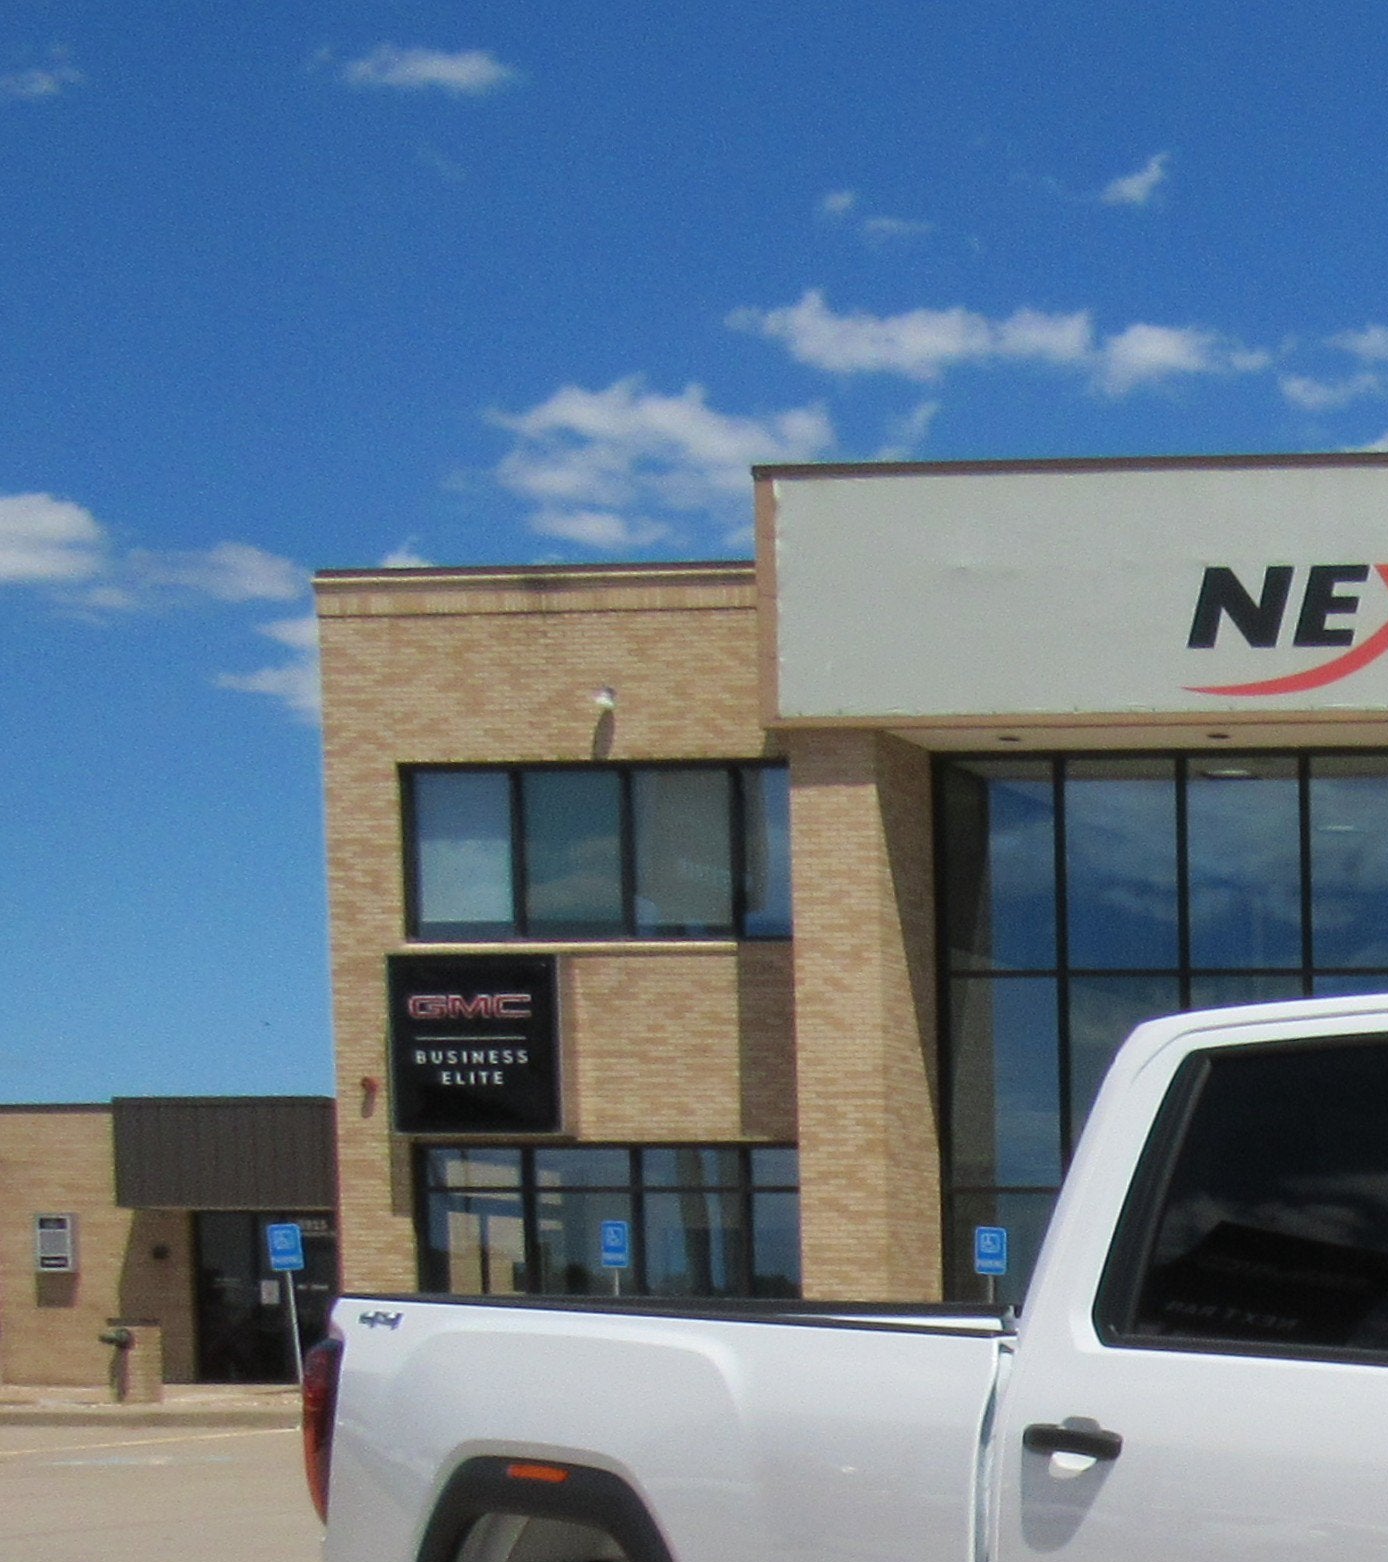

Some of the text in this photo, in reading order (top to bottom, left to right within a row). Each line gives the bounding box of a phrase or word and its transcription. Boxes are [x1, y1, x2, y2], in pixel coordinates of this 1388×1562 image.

[409, 994, 532, 1019] GMC
[415, 1050, 529, 1065] BUSINESS
[441, 1071, 504, 1085] ELITE
